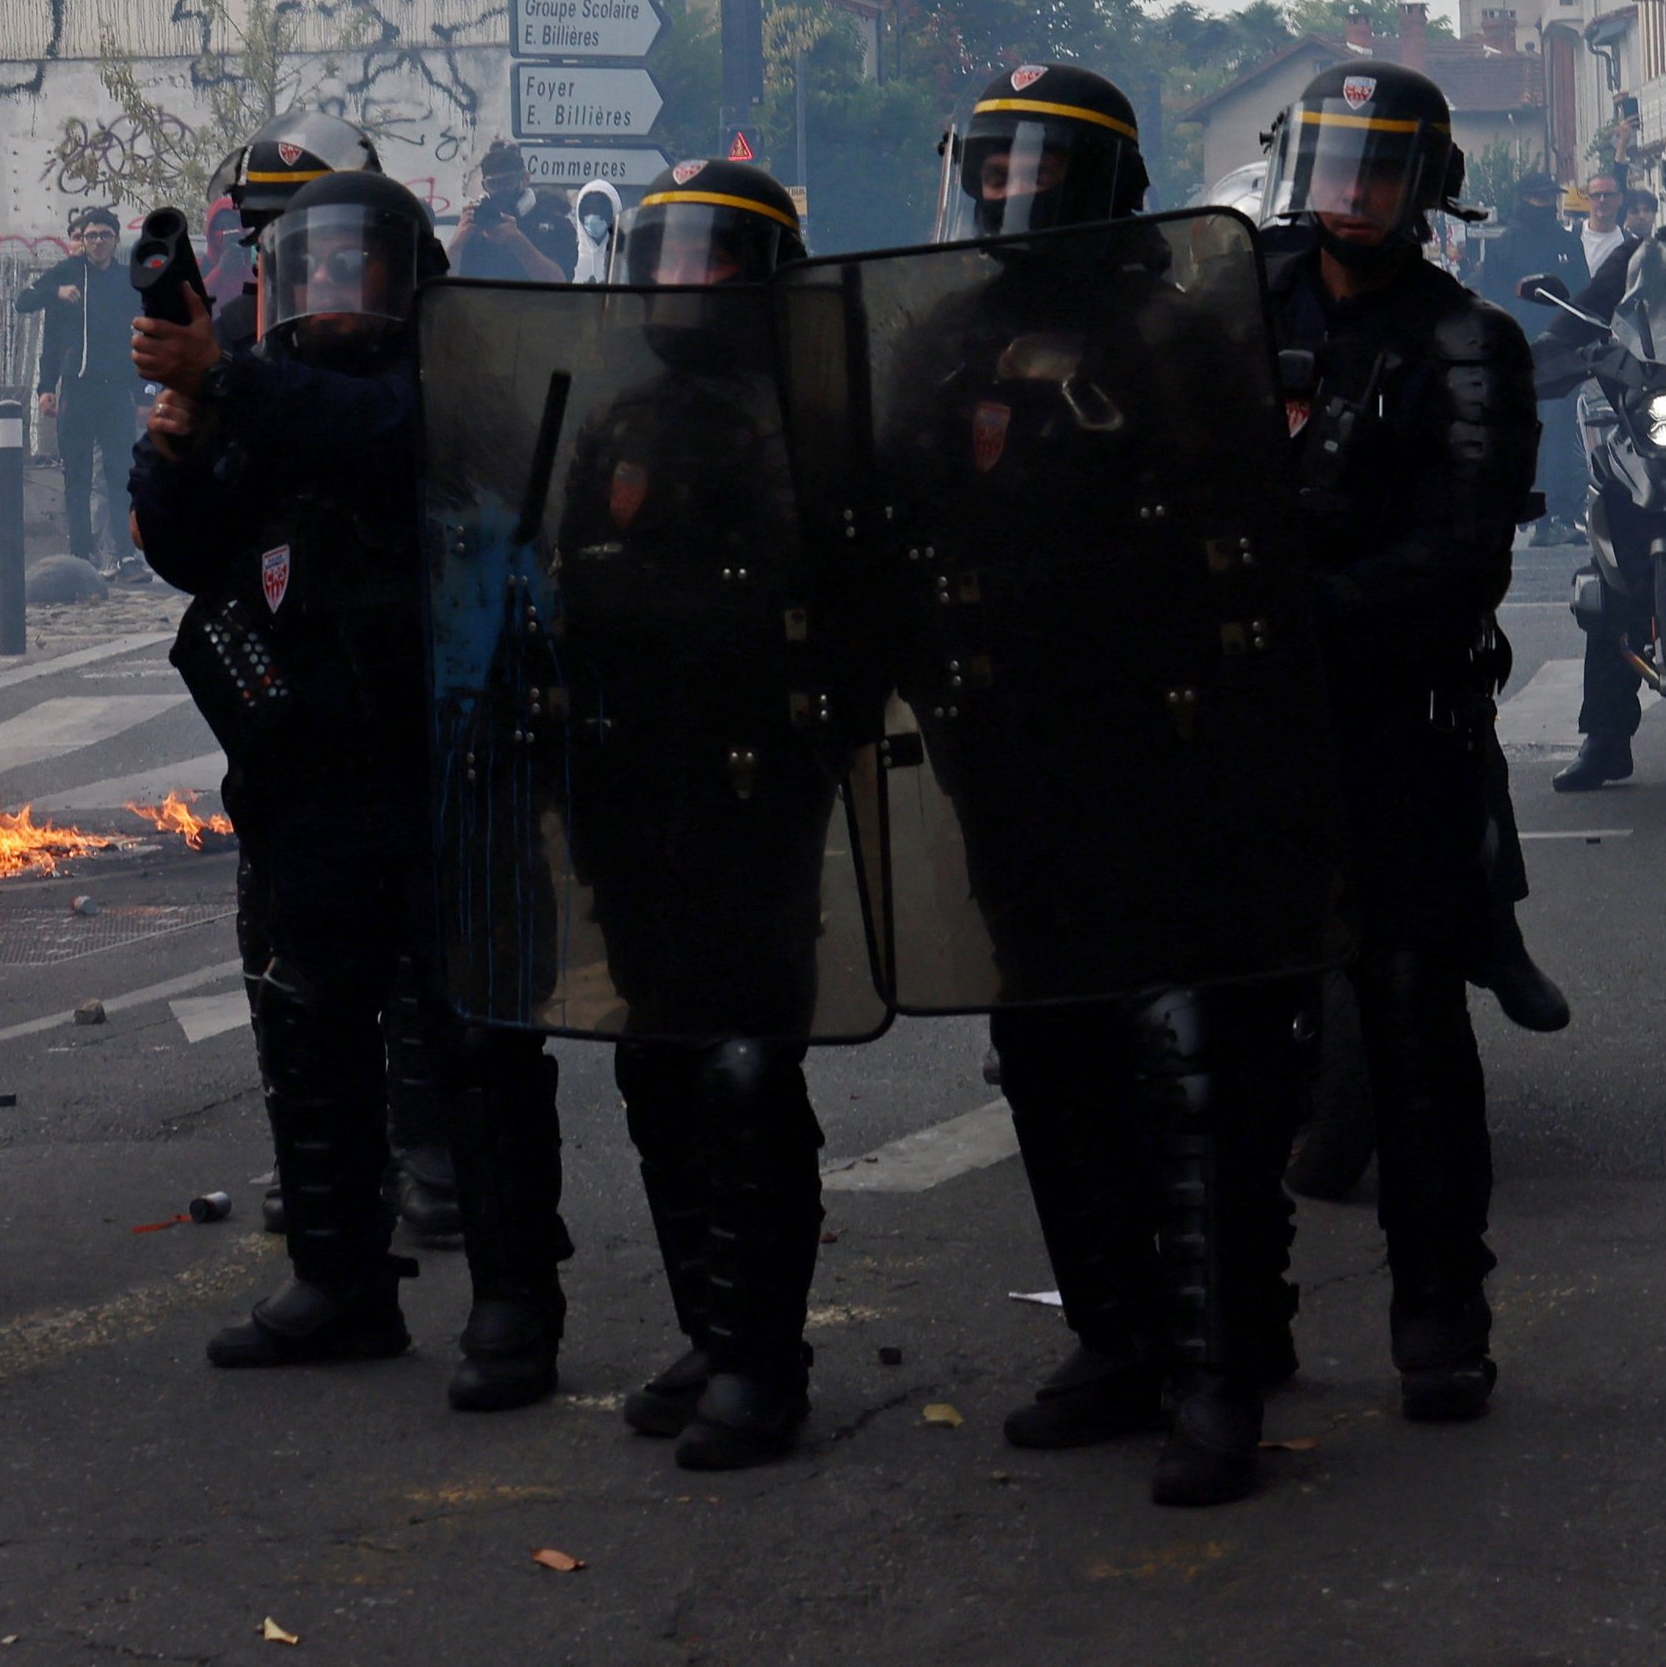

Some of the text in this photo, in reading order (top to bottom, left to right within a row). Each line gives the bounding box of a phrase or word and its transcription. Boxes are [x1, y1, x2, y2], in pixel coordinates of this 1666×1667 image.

[525, 25, 599, 46] E. Billières
[526, 76, 575, 101] Foyer
[527, 105, 631, 126] E. Billières
[527, 155, 626, 177] Commerces
